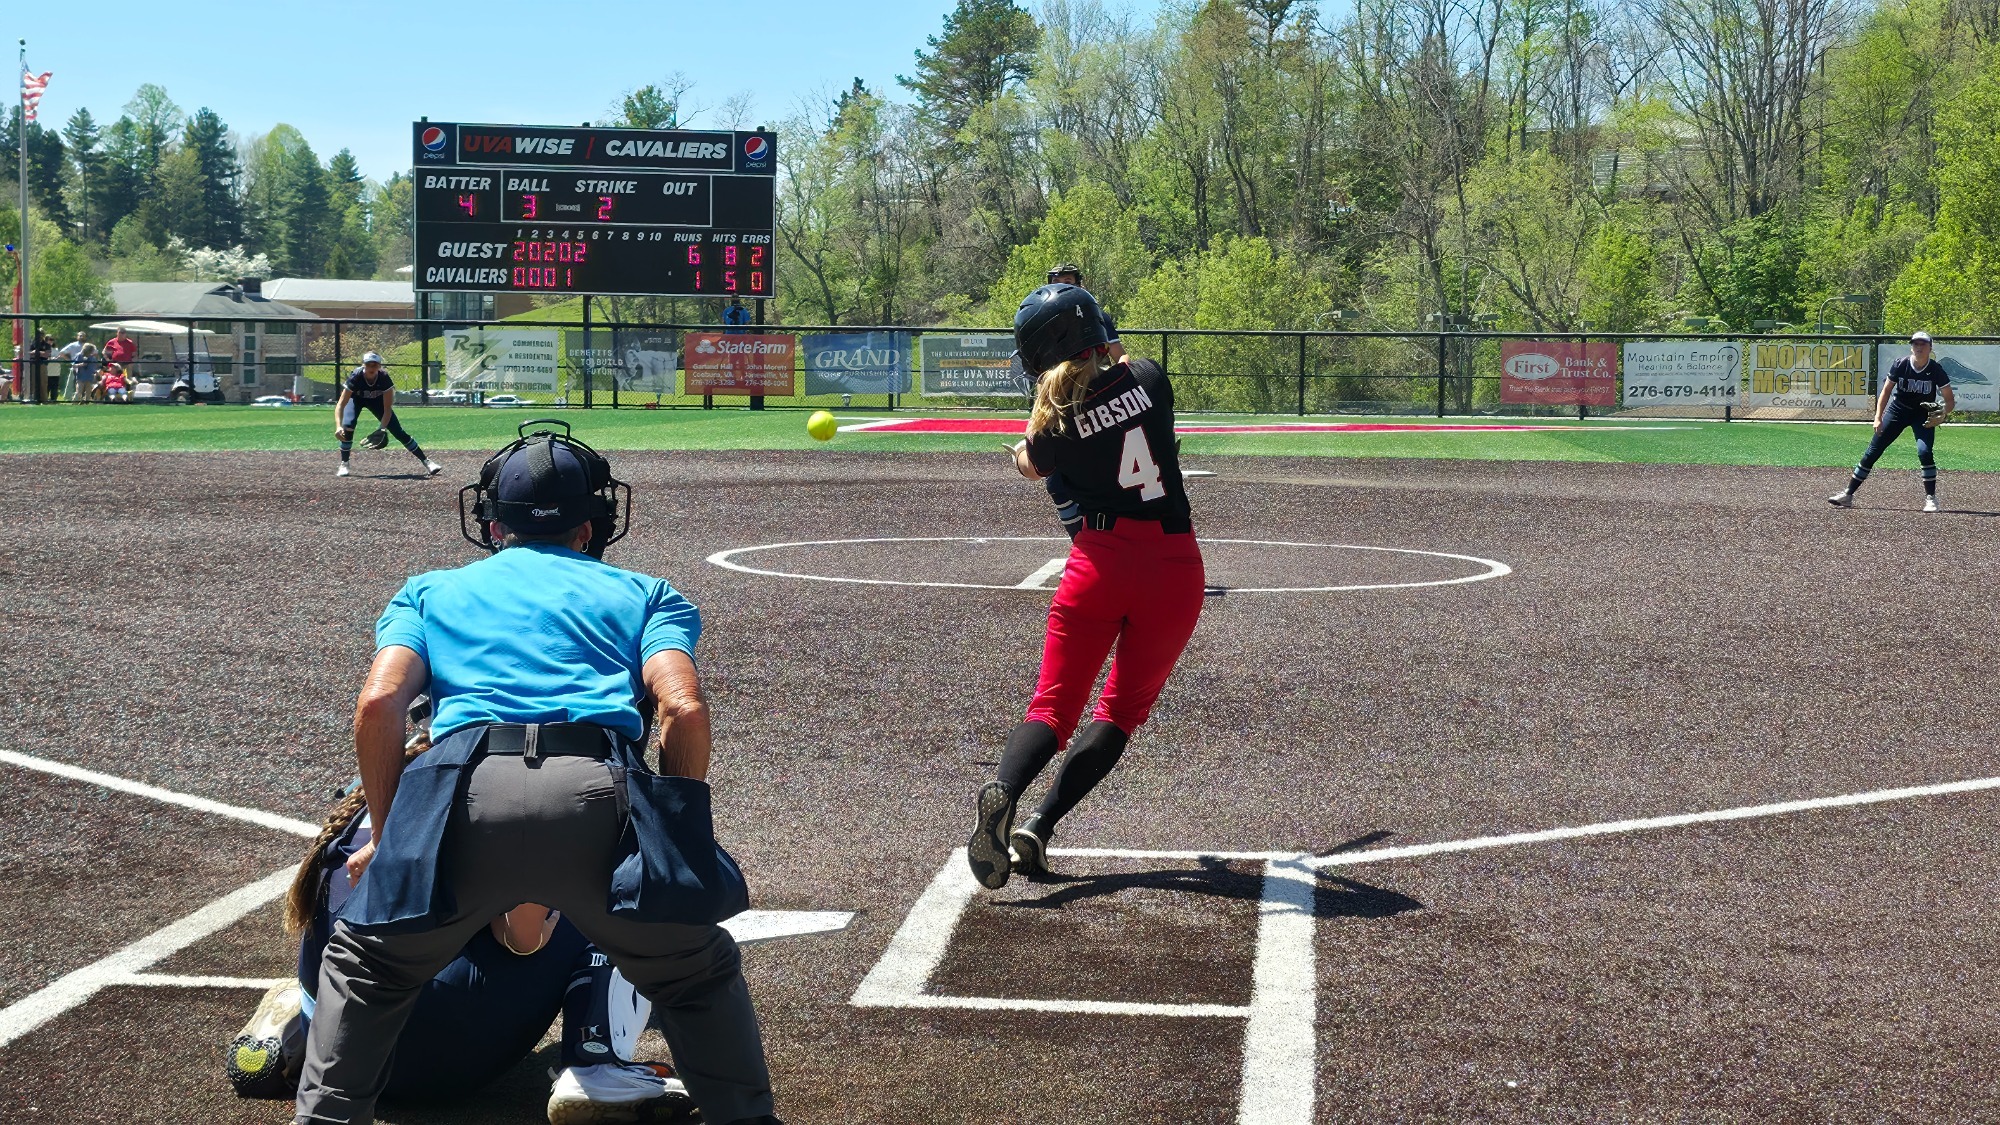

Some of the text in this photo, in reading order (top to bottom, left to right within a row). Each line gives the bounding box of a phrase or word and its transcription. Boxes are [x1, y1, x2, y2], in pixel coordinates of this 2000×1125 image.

[423, 152, 445, 160] pepsi
[605, 139, 728, 160] CAVALIERS
[745, 161, 767, 169] pepsi
[424, 175, 492, 190] BATTER
[507, 178, 698, 196] BALL STRIKE OUT
[458, 193, 474, 217] 4
[522, 194, 537, 218] 3
[598, 196, 613, 221] 2
[516, 229, 771, 244] 1 2 3 4 5 6 7 8 9 10 RUNS HITS ERRS
[437, 241, 508, 259] GUEST
[687, 245, 762, 266] 6 8 2
[426, 266, 508, 284] CAVALIERS
[695, 270, 762, 291] 1 5 0
[1075, 304, 1084, 318] 4
[512, 340, 553, 348] COMMERCIAL
[596, 358, 624, 366] BUILD
[815, 349, 900, 371] GRAND
[1565, 356, 1607, 368] Bank &
[1627, 351, 1734, 363] Mountain Empire
[1756, 344, 1864, 370] MORGAN
[940, 369, 1011, 379] THE UVA WISE
[1514, 360, 1551, 374] First
[1560, 367, 1612, 378] Trust Co.
[1638, 363, 1673, 371] Hearing
[1676, 363, 1683, 371] &
[1753, 369, 1867, 395] McCLURE
[1628, 385, 1736, 397] 276-679-4114
[1831, 398, 1847, 407] VA
[1073, 385, 1153, 439] GIBSON
[1117, 425, 1166, 502] 4
